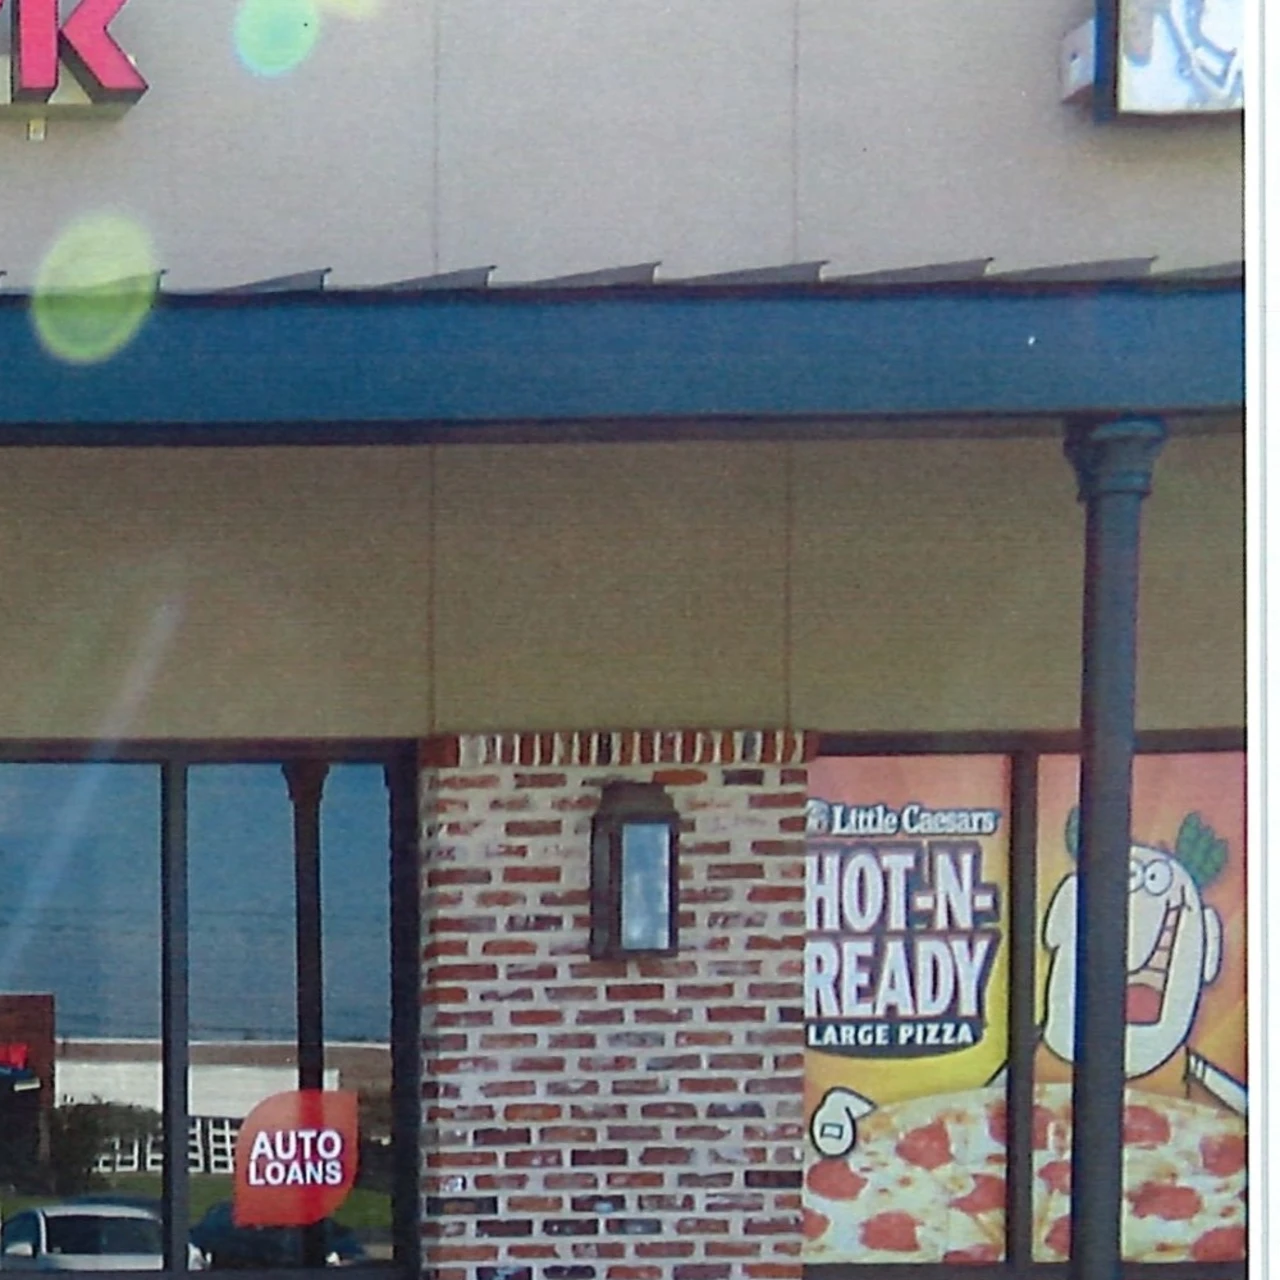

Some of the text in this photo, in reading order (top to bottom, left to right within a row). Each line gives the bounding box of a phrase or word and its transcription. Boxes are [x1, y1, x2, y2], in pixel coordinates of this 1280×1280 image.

[831, 803, 998, 836] Little Caesars
[804, 851, 995, 932] HOT-N-
[804, 937, 991, 1018] READY
[808, 1023, 974, 1046] LARGE PIZZA
[250, 1129, 343, 1161] AUTO
[248, 1160, 344, 1186] LOANS
